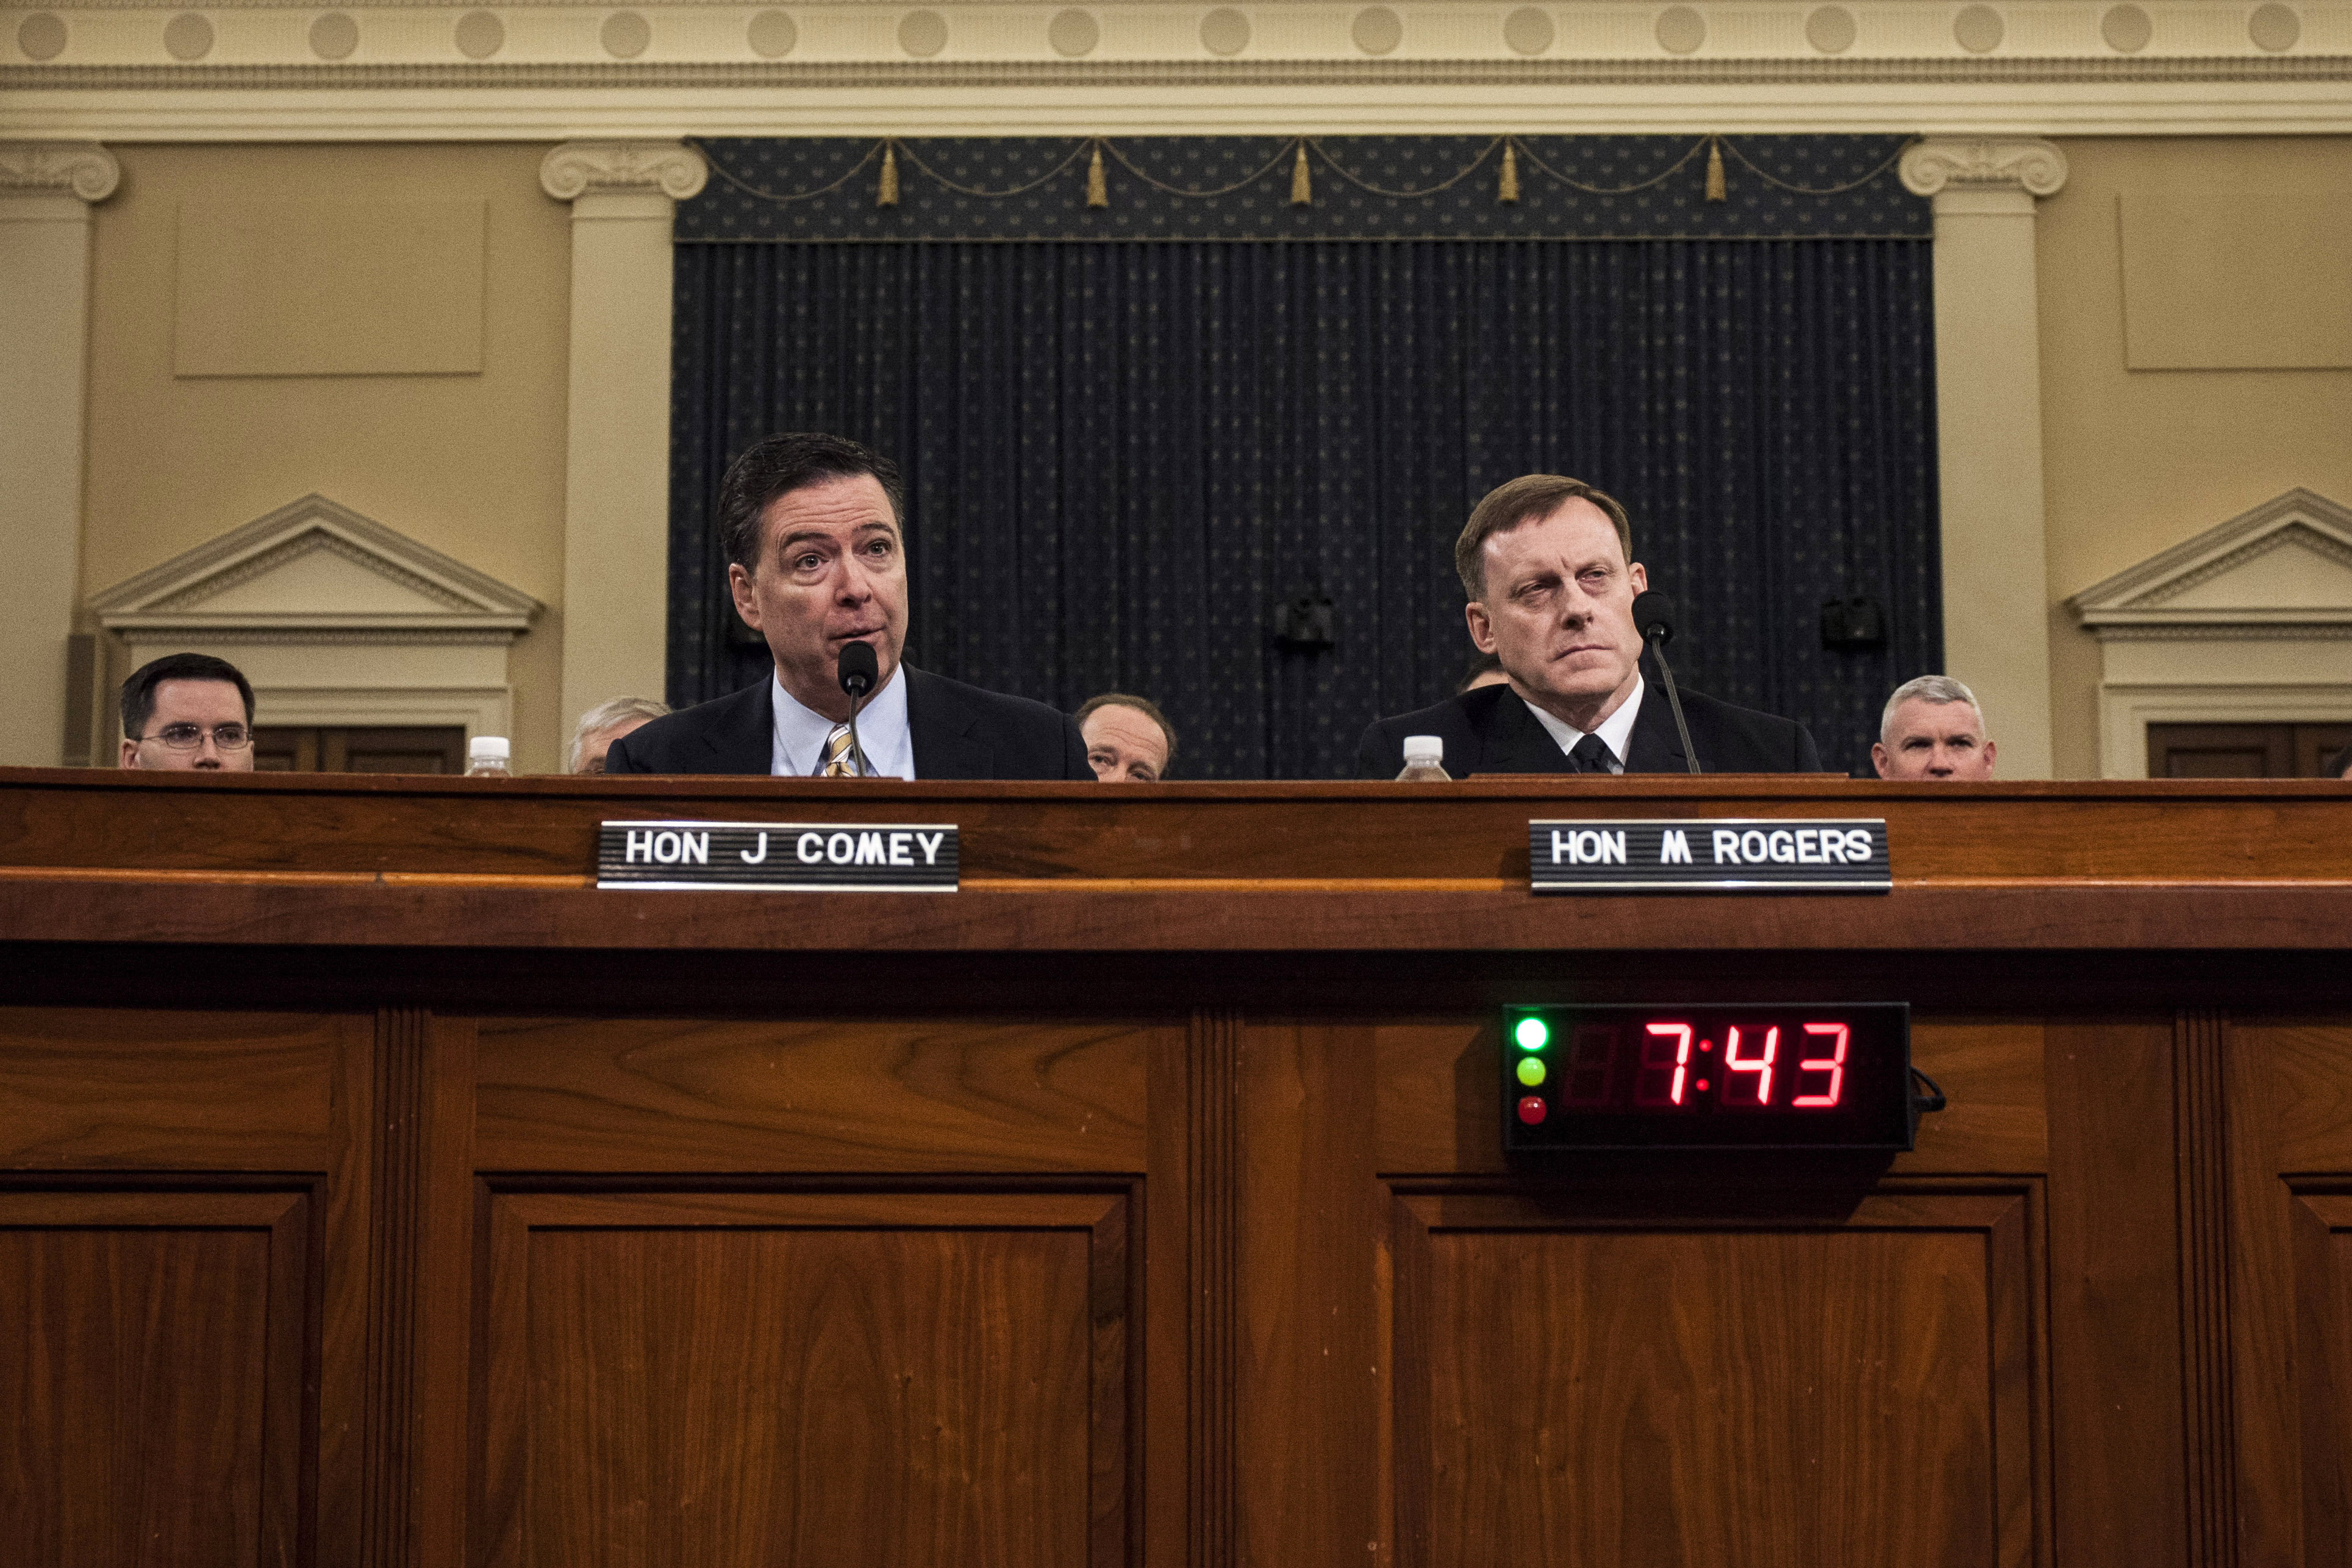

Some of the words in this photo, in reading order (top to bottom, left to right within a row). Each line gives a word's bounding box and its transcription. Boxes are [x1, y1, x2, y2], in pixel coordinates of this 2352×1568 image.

[626, 830, 710, 864] HON
[741, 832, 768, 864] J
[796, 832, 944, 866] COMEY
[1551, 830, 1626, 864] HON
[1660, 829, 1693, 864] M
[1712, 829, 1873, 864] ROGERS
[1645, 1022, 1850, 1108] 7:43
